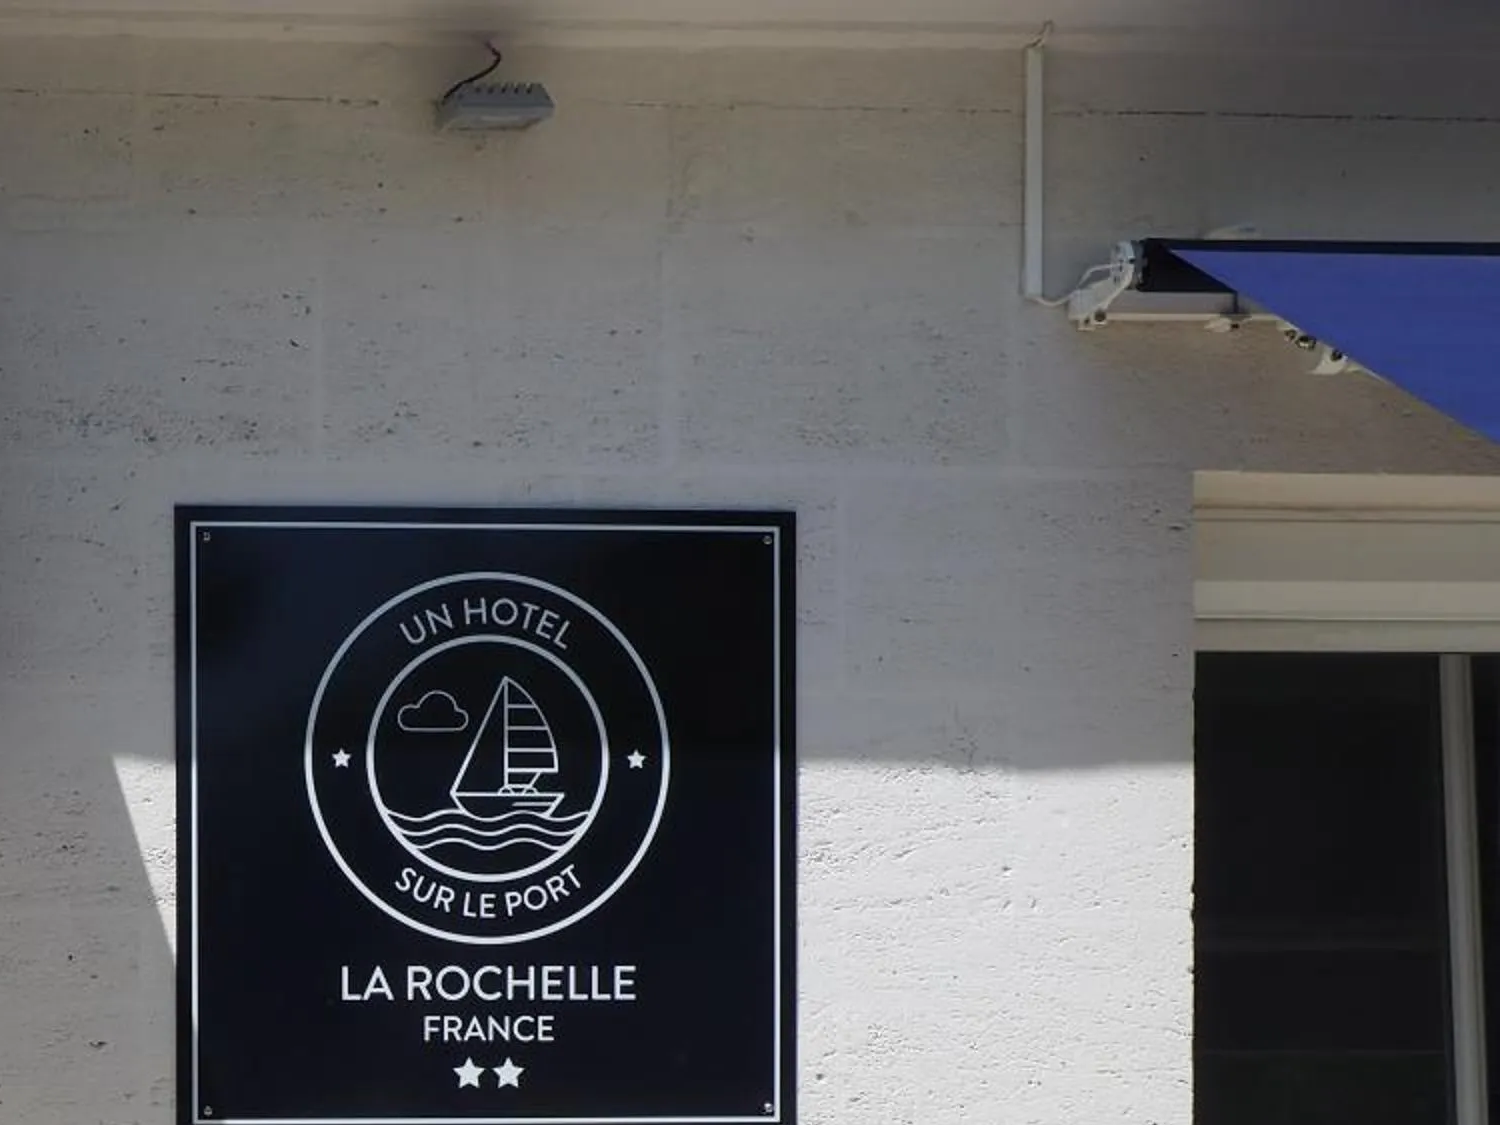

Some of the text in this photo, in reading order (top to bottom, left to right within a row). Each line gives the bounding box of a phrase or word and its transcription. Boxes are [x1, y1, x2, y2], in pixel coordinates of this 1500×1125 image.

[399, 597, 570, 650] UN HOTEL
[394, 863, 581, 919] SUR LE PORT
[341, 965, 637, 1001] LA ROCHELLE
[423, 1015, 555, 1042] FRANCE
